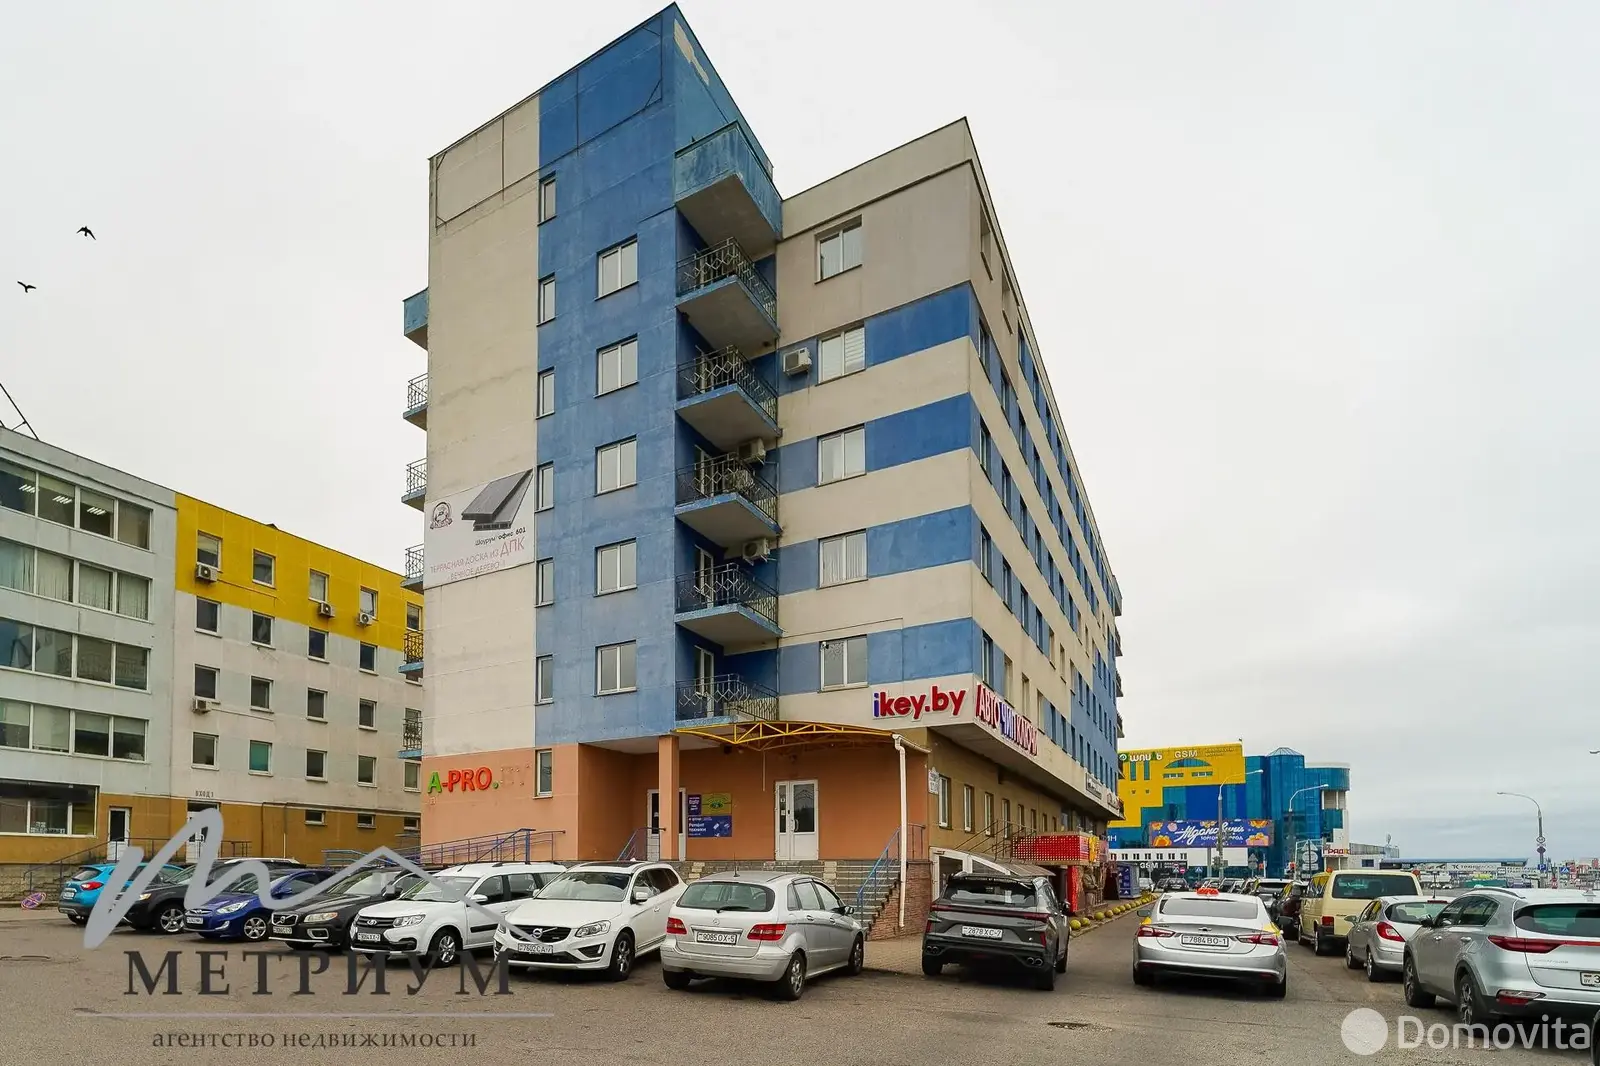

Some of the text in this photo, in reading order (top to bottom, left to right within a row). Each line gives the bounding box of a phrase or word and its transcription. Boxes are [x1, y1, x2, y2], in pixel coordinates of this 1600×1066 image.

[500, 536, 525, 558] ДПК
[873, 686, 966, 720] ikey.by
[1174, 750, 1199, 759] GSM
